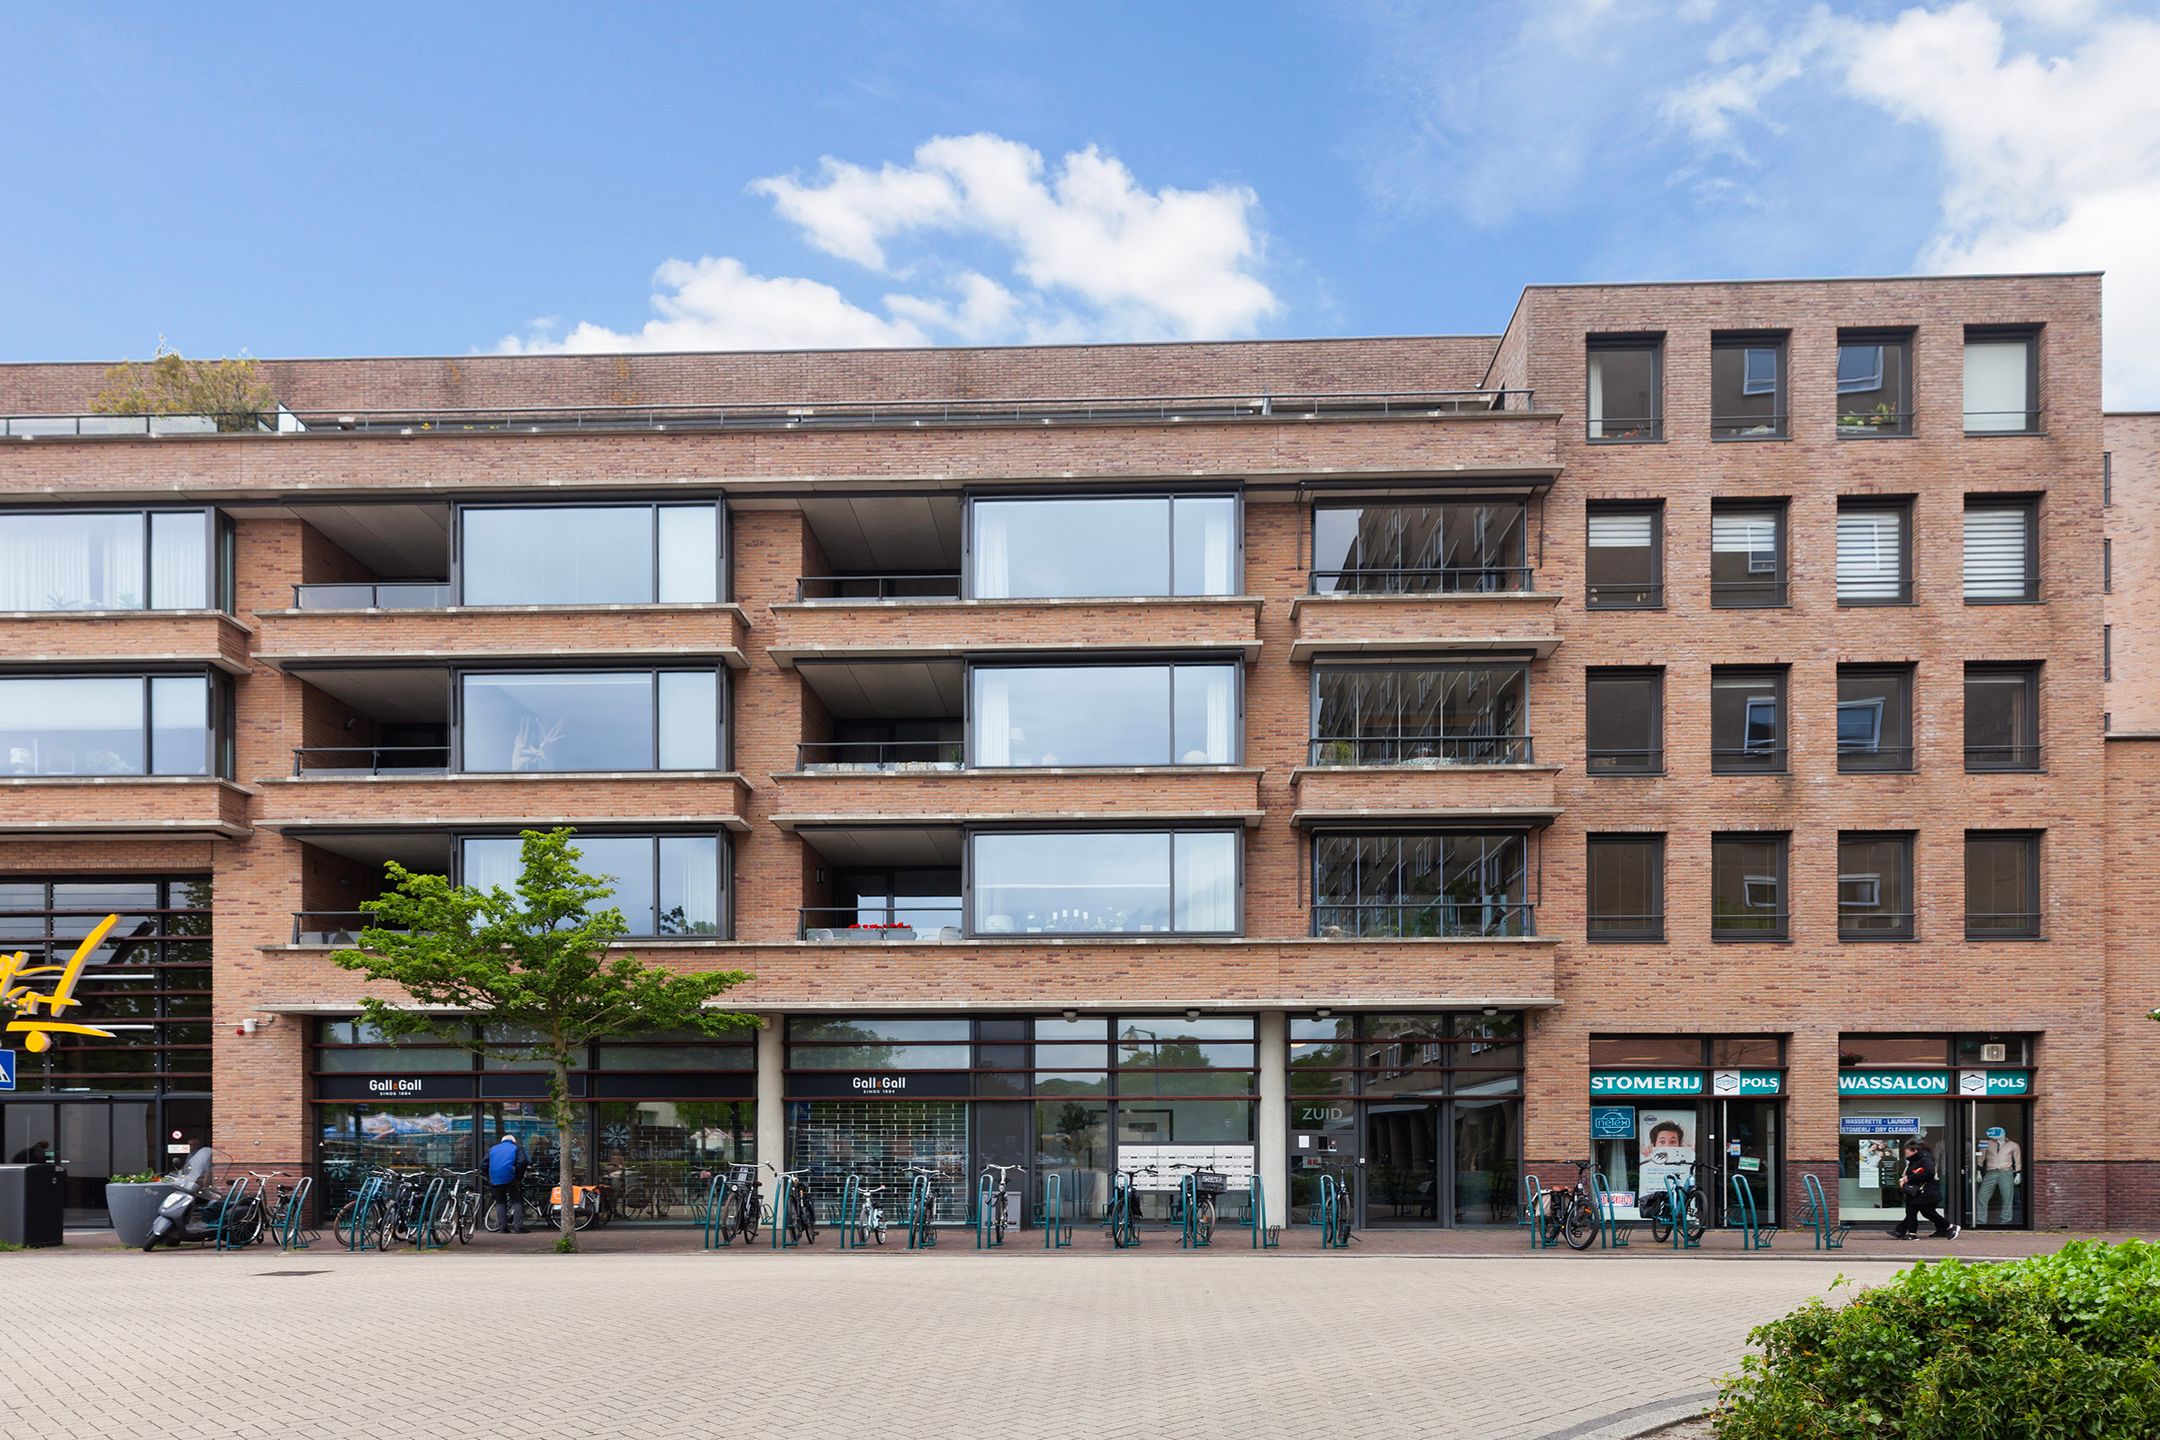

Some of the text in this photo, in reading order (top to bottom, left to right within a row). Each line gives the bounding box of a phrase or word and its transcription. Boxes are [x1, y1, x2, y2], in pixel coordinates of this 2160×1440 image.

[1591, 1076, 1700, 1090] STOMERIJ
[1741, 1077, 1778, 1088] POLS
[1839, 1076, 1946, 1090] WASSALON
[1988, 1078, 2025, 1088] POLS
[1302, 1107, 1343, 1120] ZUID
